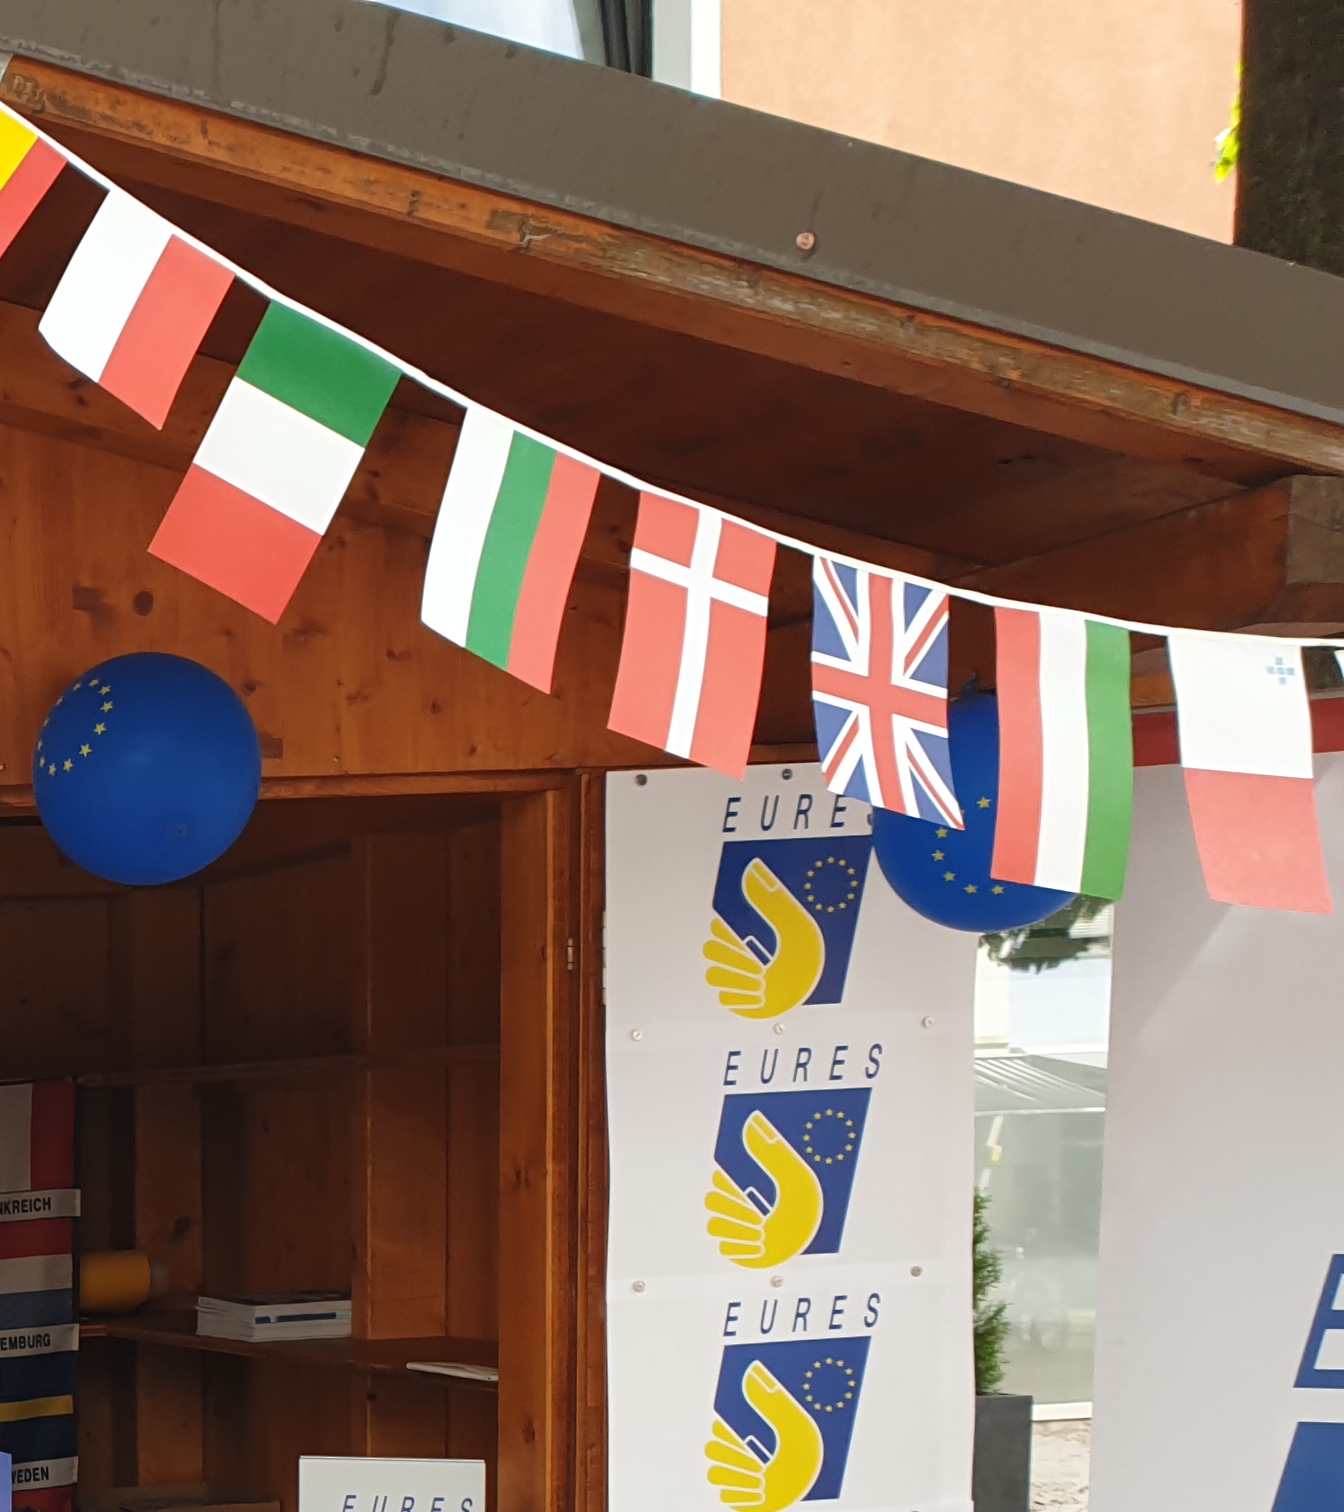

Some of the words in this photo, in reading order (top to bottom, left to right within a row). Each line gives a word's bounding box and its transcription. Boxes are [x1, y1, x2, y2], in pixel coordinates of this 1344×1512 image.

[721, 793, 872, 833] EURE
[722, 1042, 884, 1086] EURES
[722, 1292, 882, 1337] EURES
